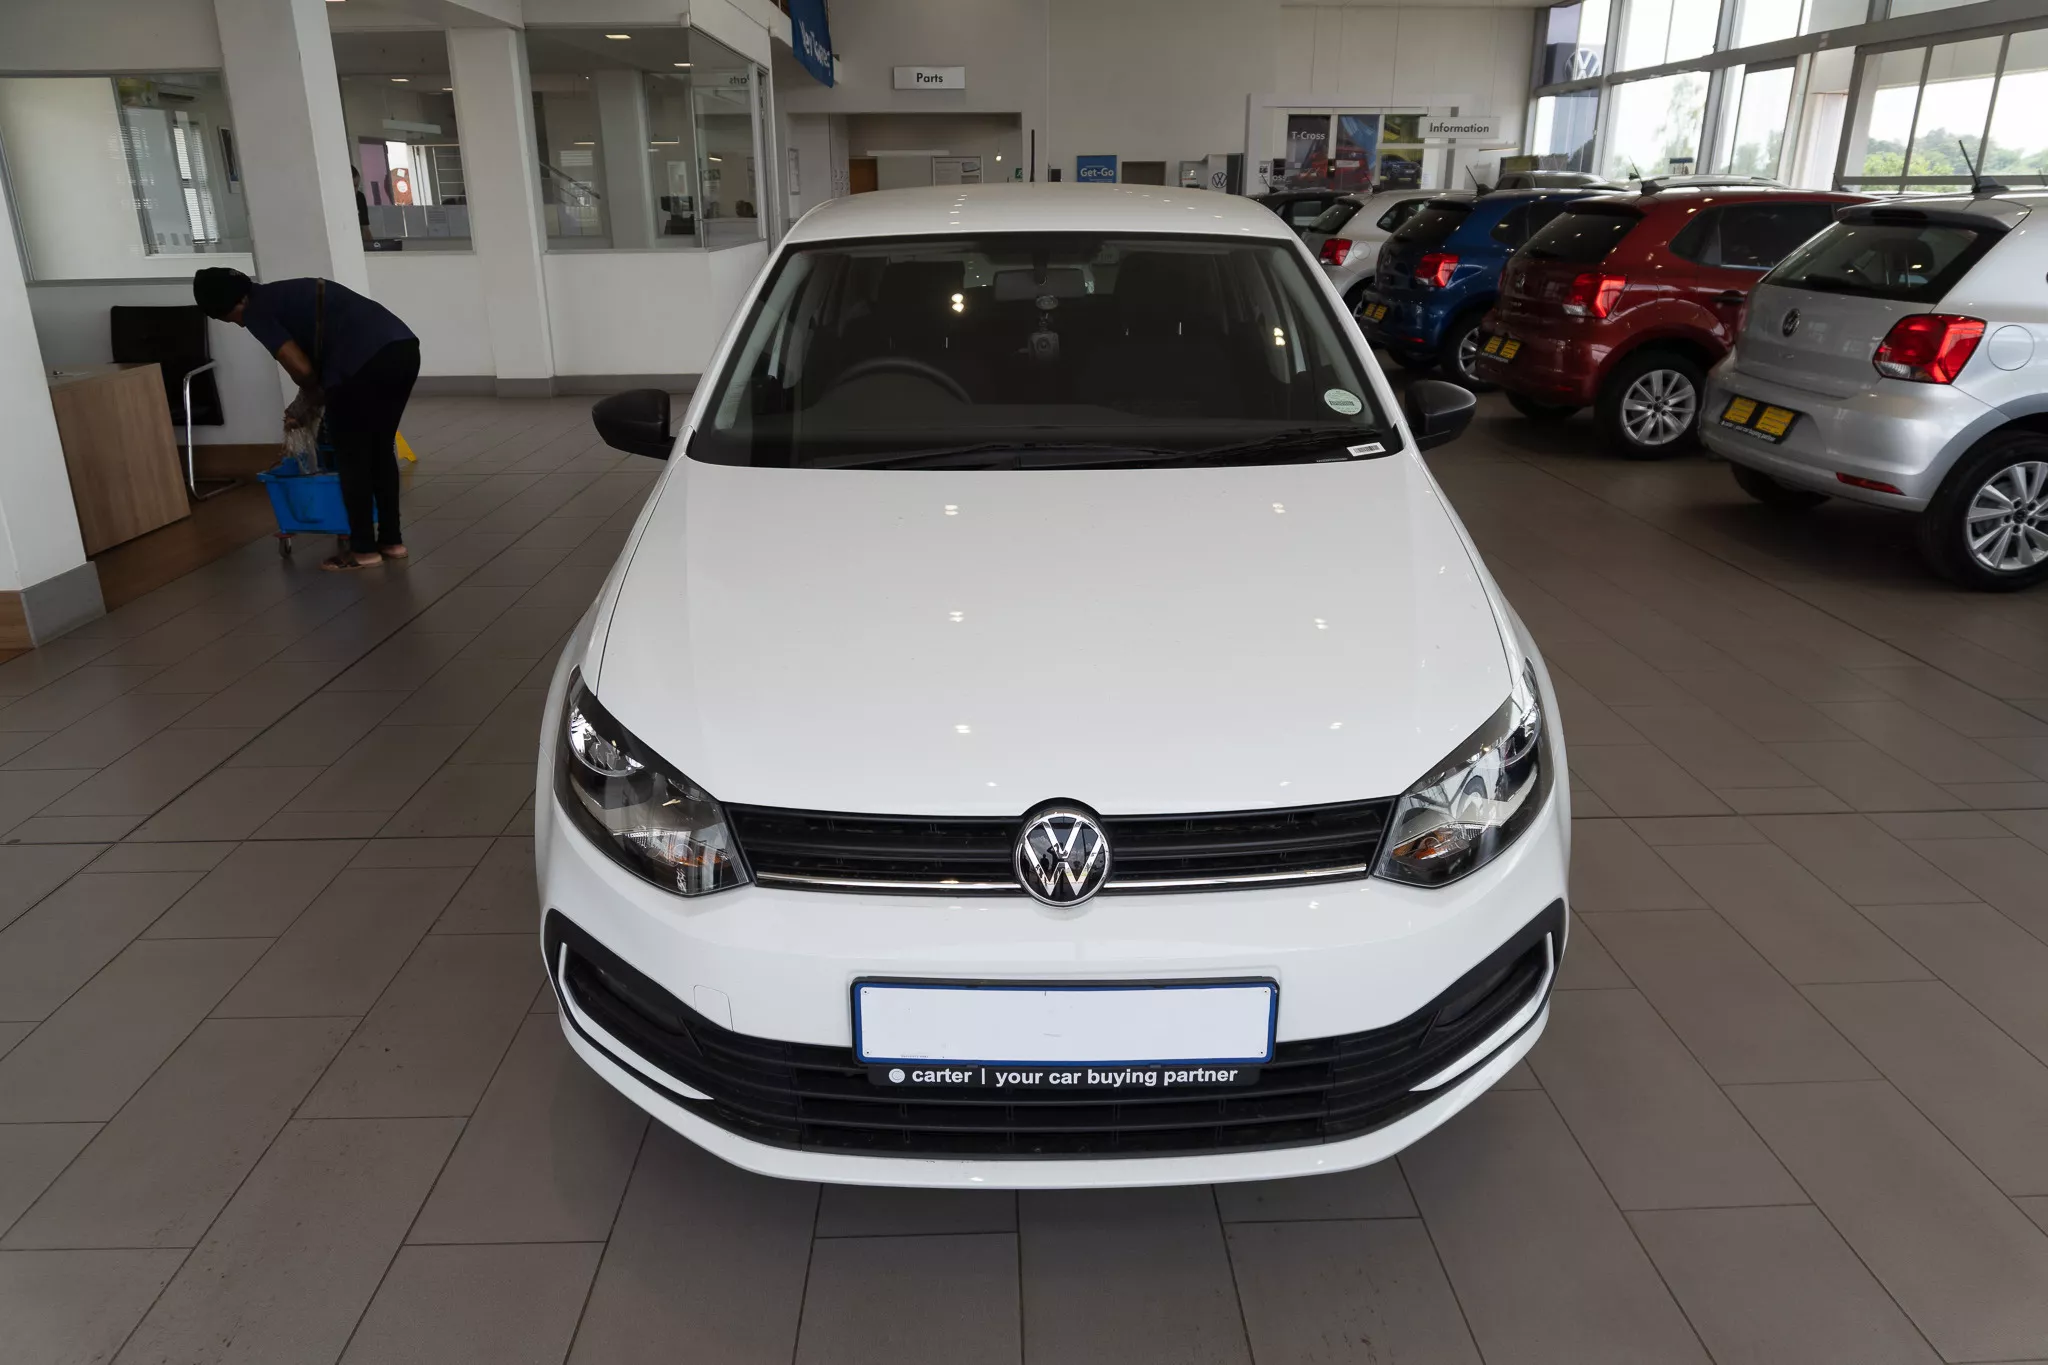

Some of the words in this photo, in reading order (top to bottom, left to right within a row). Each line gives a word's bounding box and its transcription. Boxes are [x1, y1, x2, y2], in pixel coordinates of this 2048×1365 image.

[916, 72, 943, 82] Parts
[1430, 122, 1489, 132] Information
[1291, 131, 1326, 140] T-Cross
[1080, 167, 1114, 177] Get-Go
[912, 1068, 972, 1083] carter
[995, 1071, 1043, 1088] your
[1049, 1072, 1082, 1085] car
[1087, 1068, 1157, 1088] buying
[1163, 1067, 1239, 1086] partner
